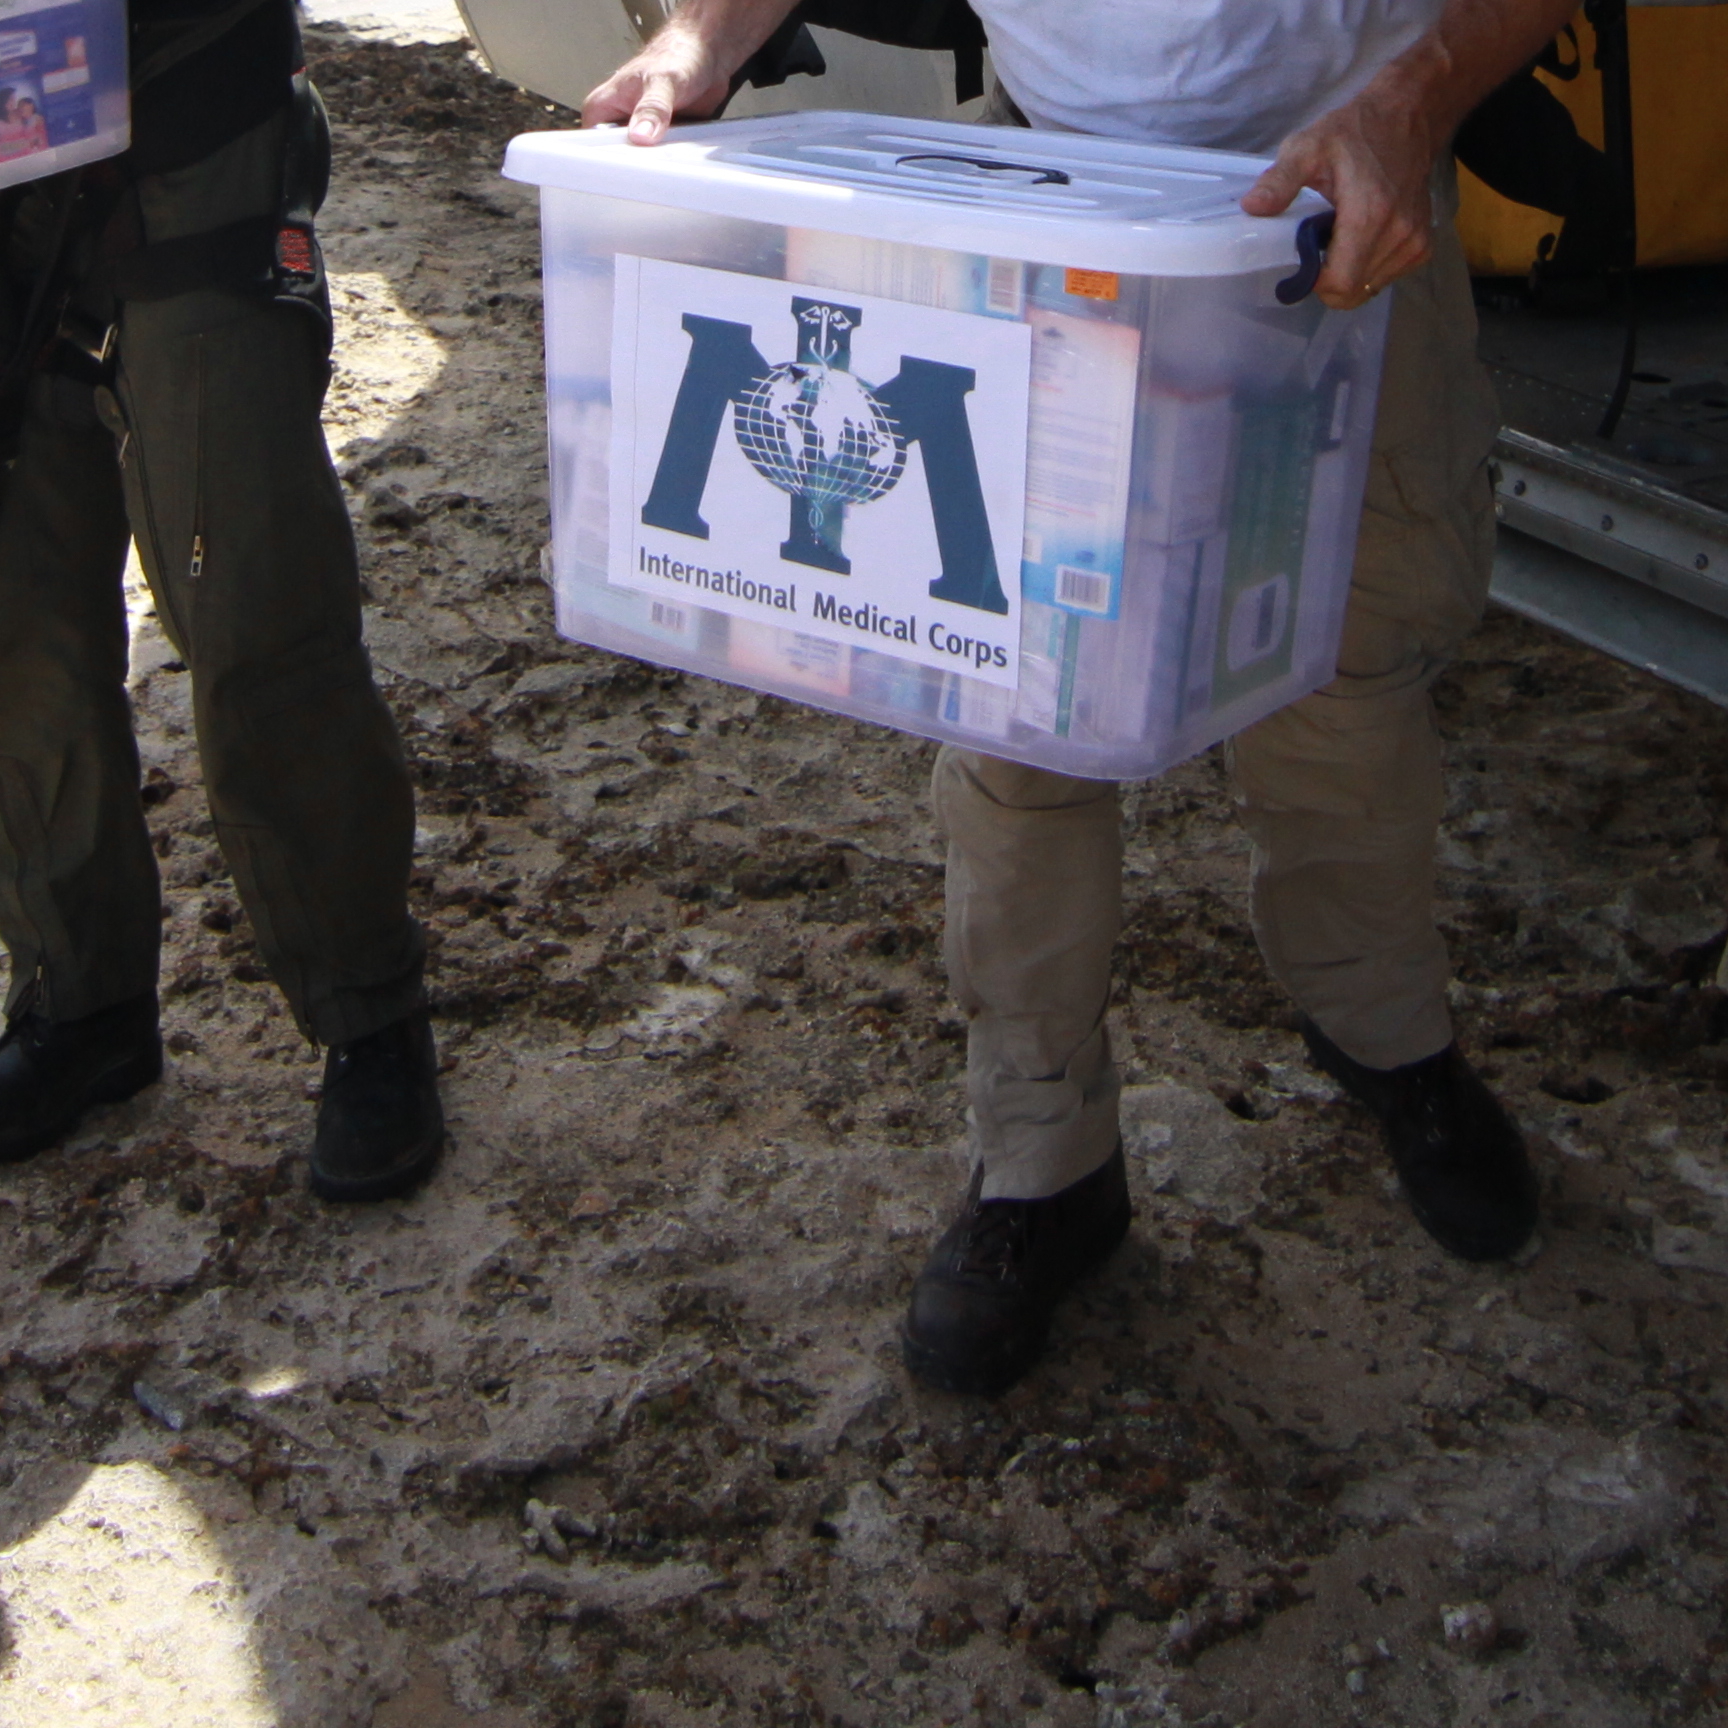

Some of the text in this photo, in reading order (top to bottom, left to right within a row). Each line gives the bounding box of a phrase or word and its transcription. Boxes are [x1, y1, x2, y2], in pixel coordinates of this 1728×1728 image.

[638, 545, 1008, 669] International Medical Corps
